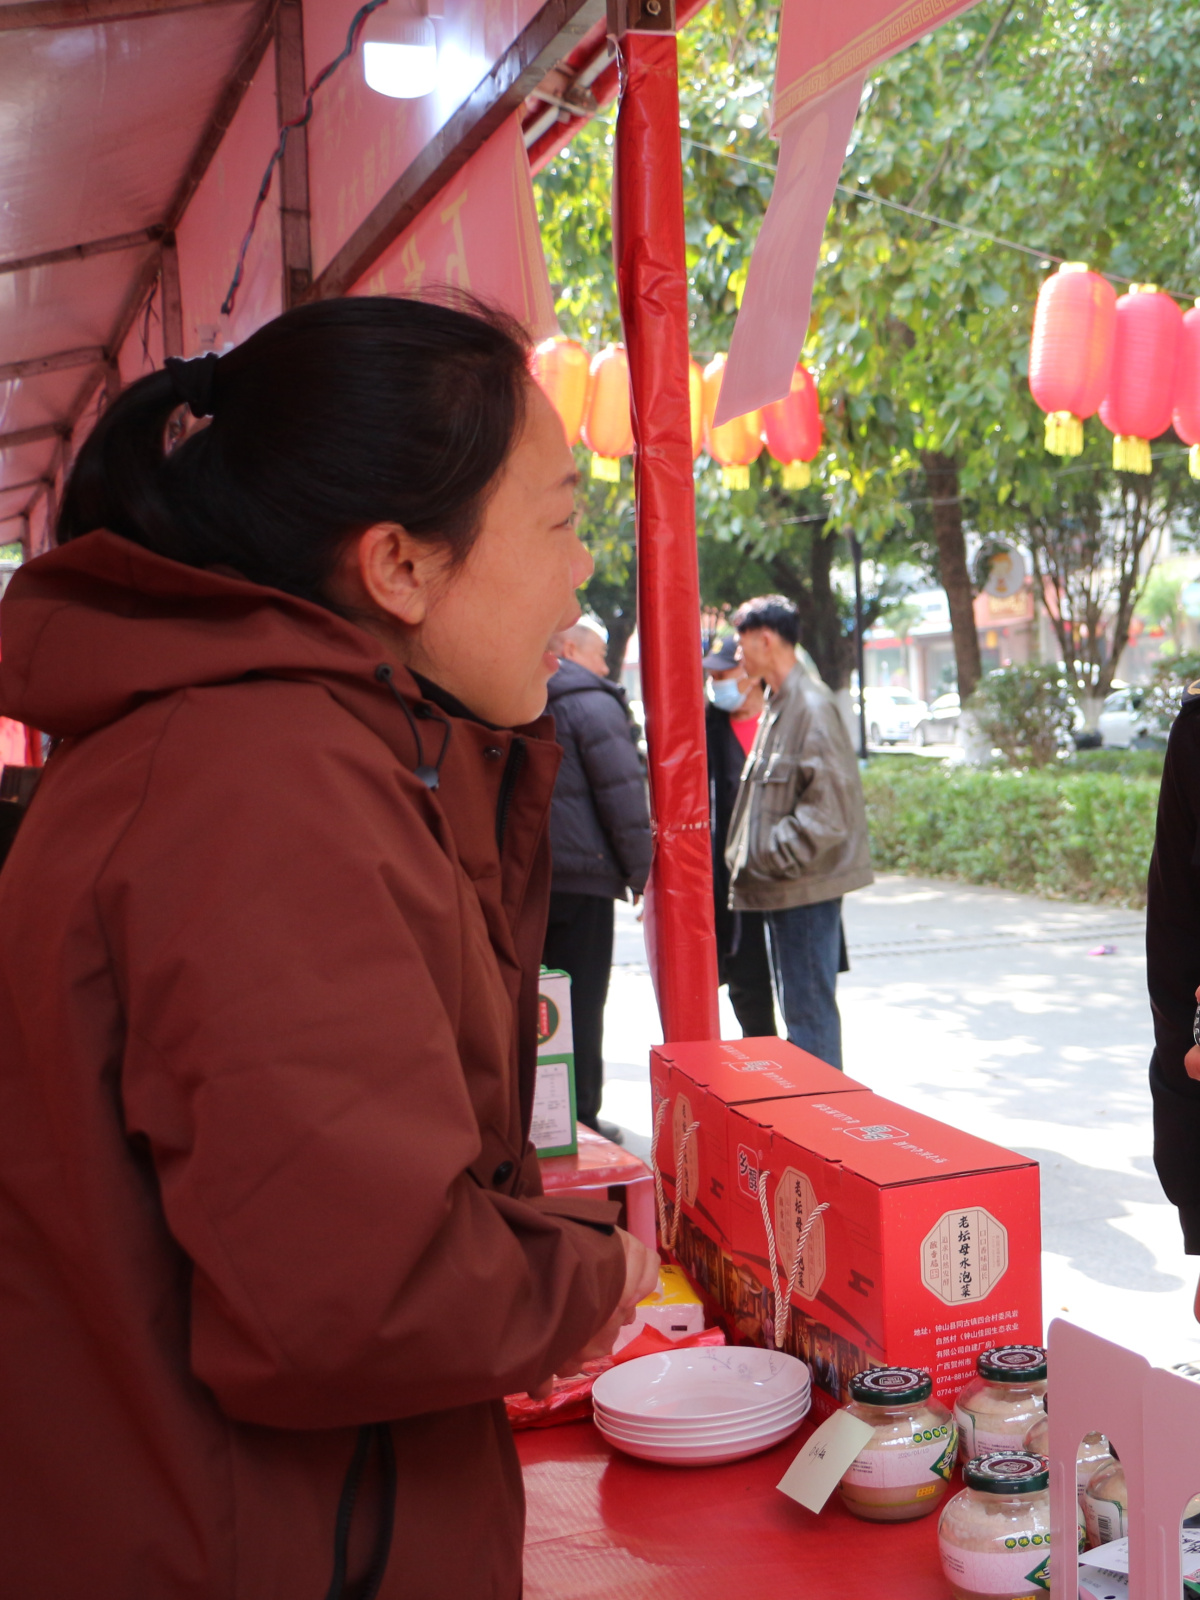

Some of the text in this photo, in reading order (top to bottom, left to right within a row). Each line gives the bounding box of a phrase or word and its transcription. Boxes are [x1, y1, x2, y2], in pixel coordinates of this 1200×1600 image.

[958, 1215, 972, 1298] 老坛母水泡菜
